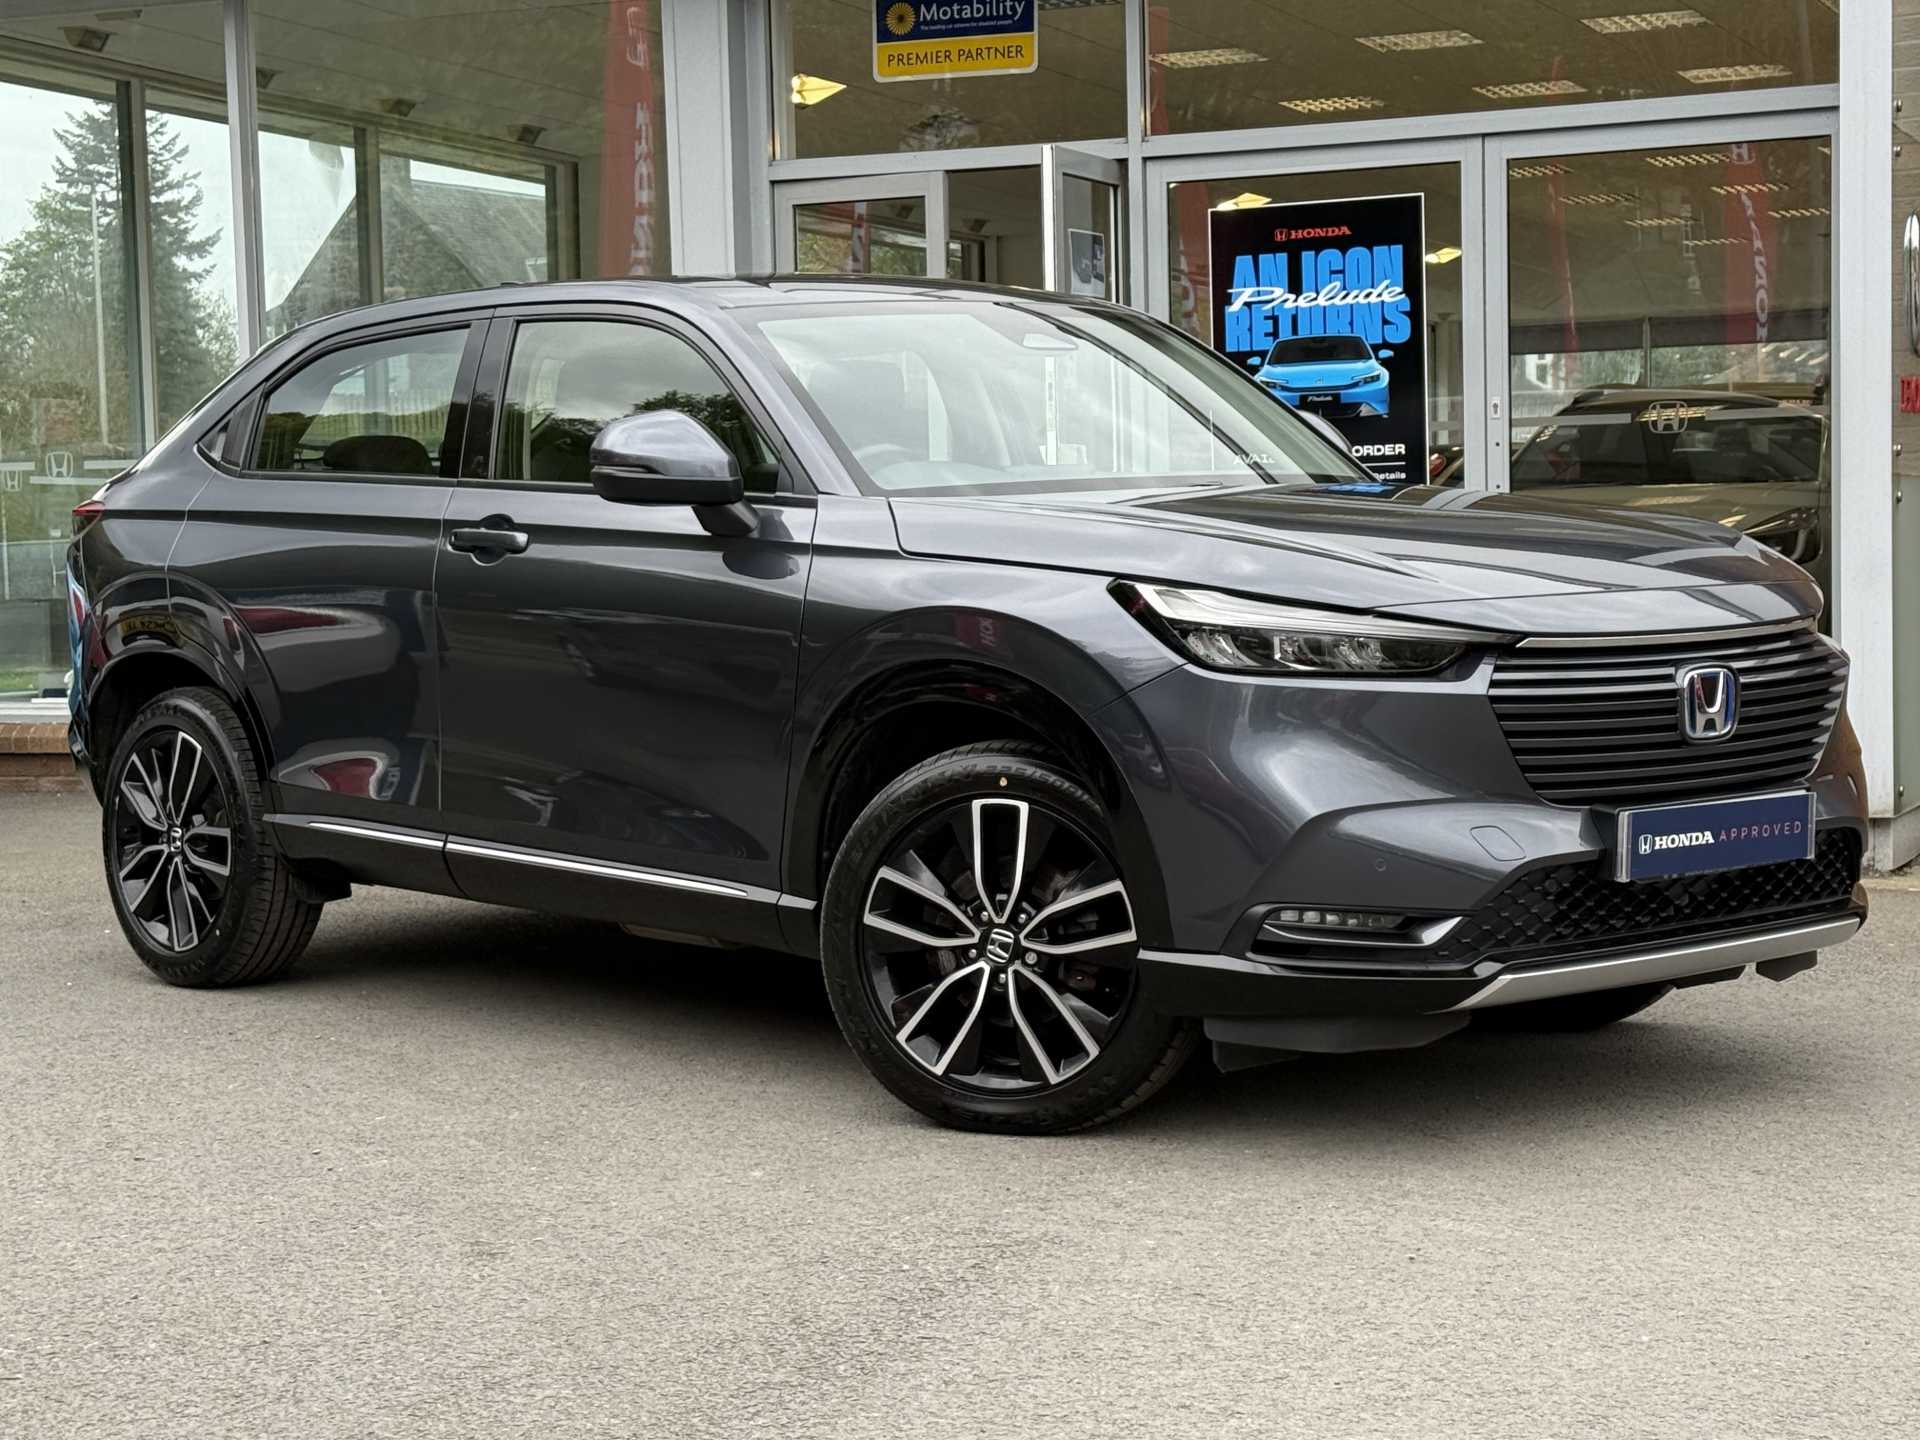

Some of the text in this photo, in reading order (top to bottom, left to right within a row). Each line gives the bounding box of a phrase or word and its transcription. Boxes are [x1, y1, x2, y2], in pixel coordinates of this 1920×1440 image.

[919, 0, 1025, 21] Motability
[887, 44, 1025, 68] PREMIER PARTNER
[1289, 225, 1352, 240] HONDA
[1231, 252, 1289, 303] AN
[1301, 245, 1404, 296] ICON
[1226, 279, 1406, 312] Prelude
[1224, 296, 1412, 353] RETURNS
[1352, 443, 1406, 457] ORDER
[1654, 820, 1802, 850] HONDA APPROVED
